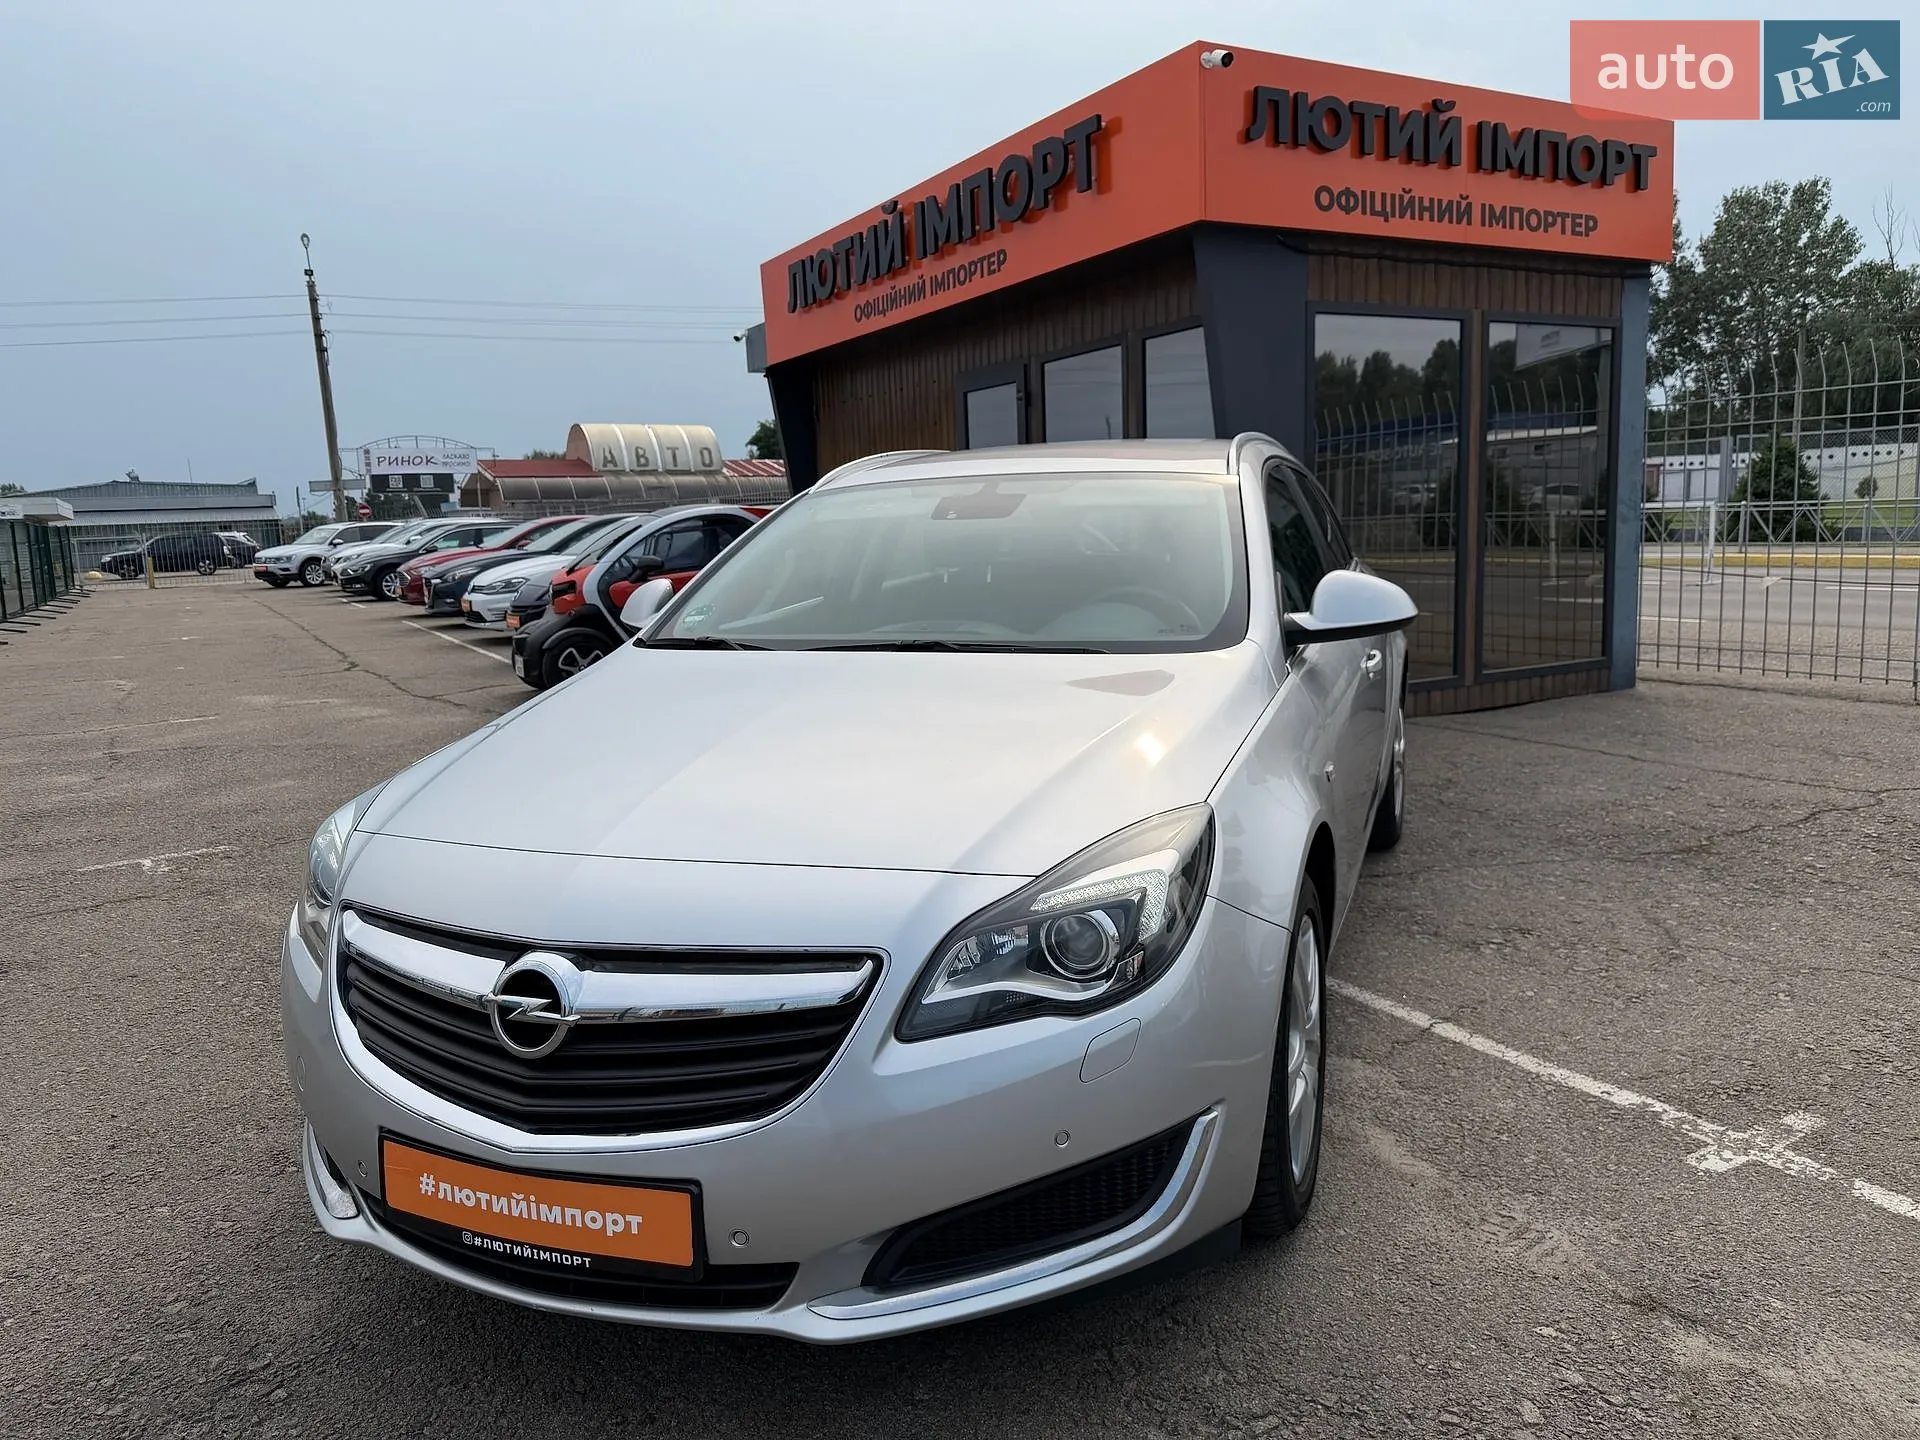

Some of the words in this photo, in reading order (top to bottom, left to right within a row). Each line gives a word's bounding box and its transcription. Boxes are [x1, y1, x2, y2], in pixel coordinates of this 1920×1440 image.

[1249, 84, 1462, 165] ЛЮТИЙ
[1477, 121, 1657, 191] ІМПОРТ
[787, 200, 904, 314] ЛЮТИЙ
[914, 113, 1103, 260] ІМПОРТ
[1314, 184, 1474, 227] ОФІЦІЙНИЙ
[1480, 203, 1598, 237] ІМПОРТЕР
[853, 274, 927, 323] ОФІЦІЙНИЙ
[929, 248, 1008, 294] ІМПОРТЕР
[376, 455, 439, 467] РИНОК
[602, 446, 714, 468] АВТО
[419, 1172, 643, 1236] #лютийімпорт
[474, 1236, 592, 1268] #ЛЮТИЙІМПОРТ
